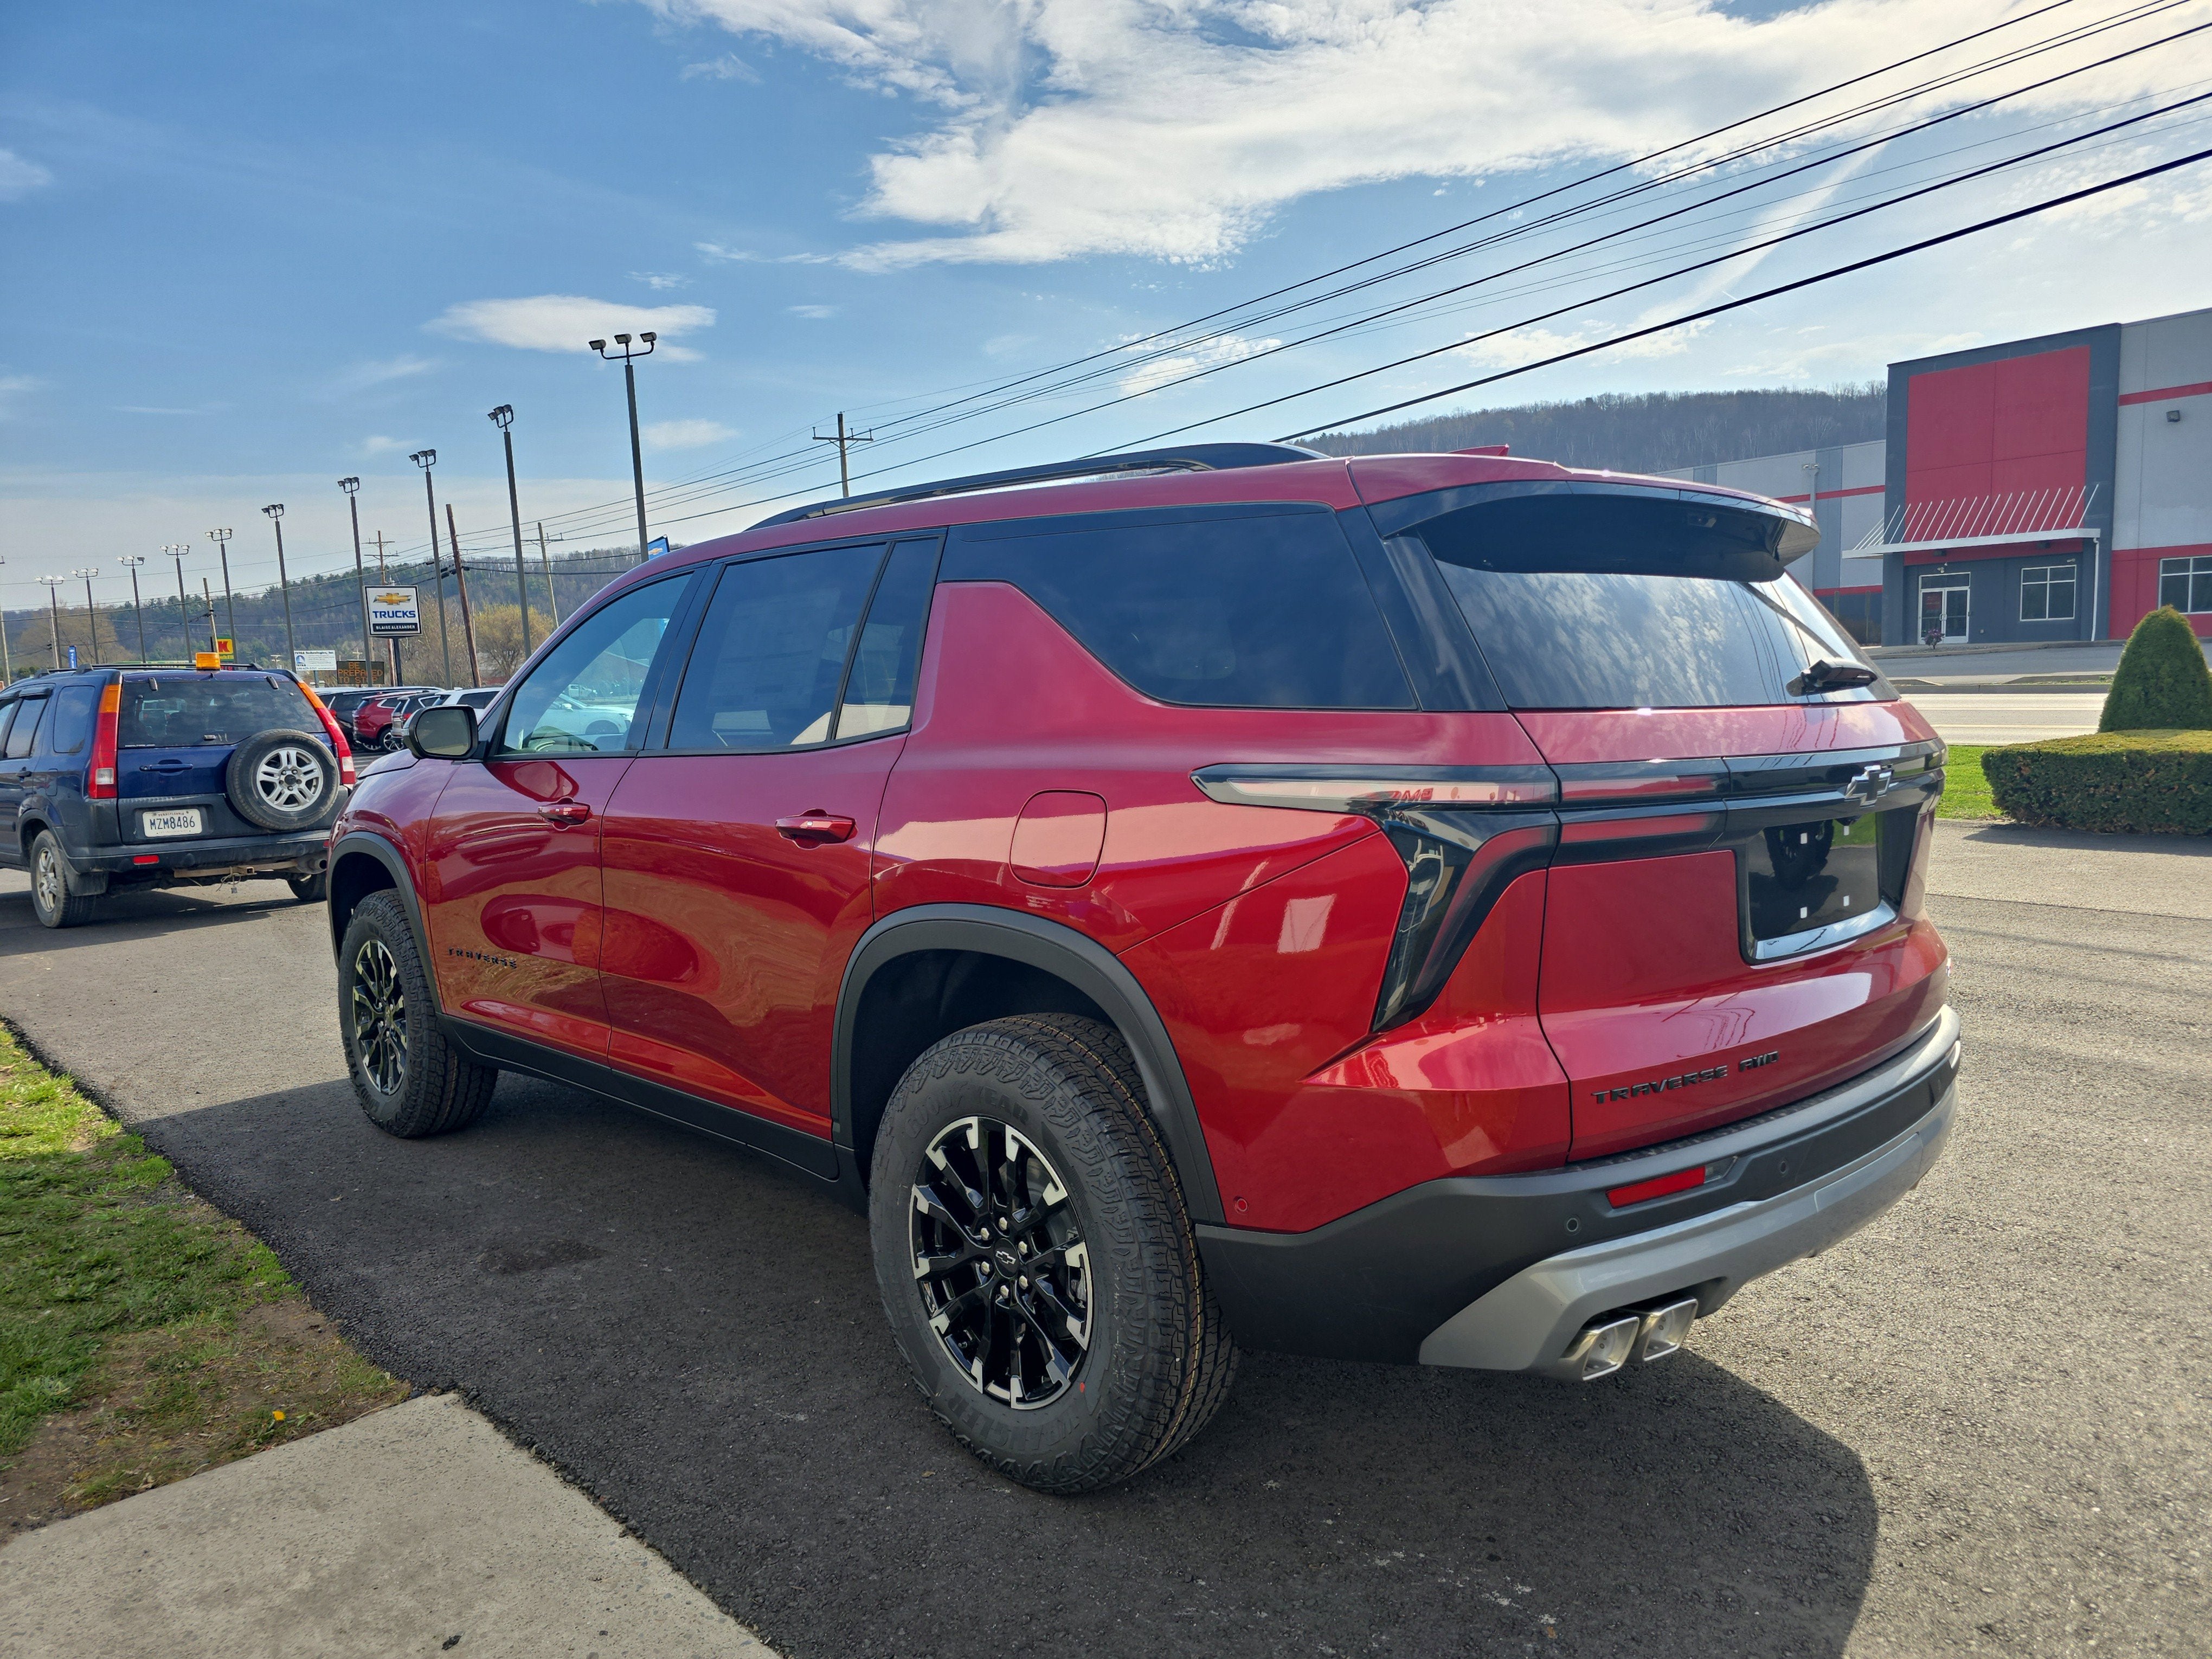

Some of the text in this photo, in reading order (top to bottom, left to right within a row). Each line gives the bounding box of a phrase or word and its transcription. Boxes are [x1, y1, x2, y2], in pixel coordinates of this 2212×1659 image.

[372, 610, 416, 619] TRUCKS
[150, 815, 195, 830] MZM8486
[448, 947, 517, 969] TRAVERSE
[1591, 1050, 1779, 1104] TRAVERSE AWD
